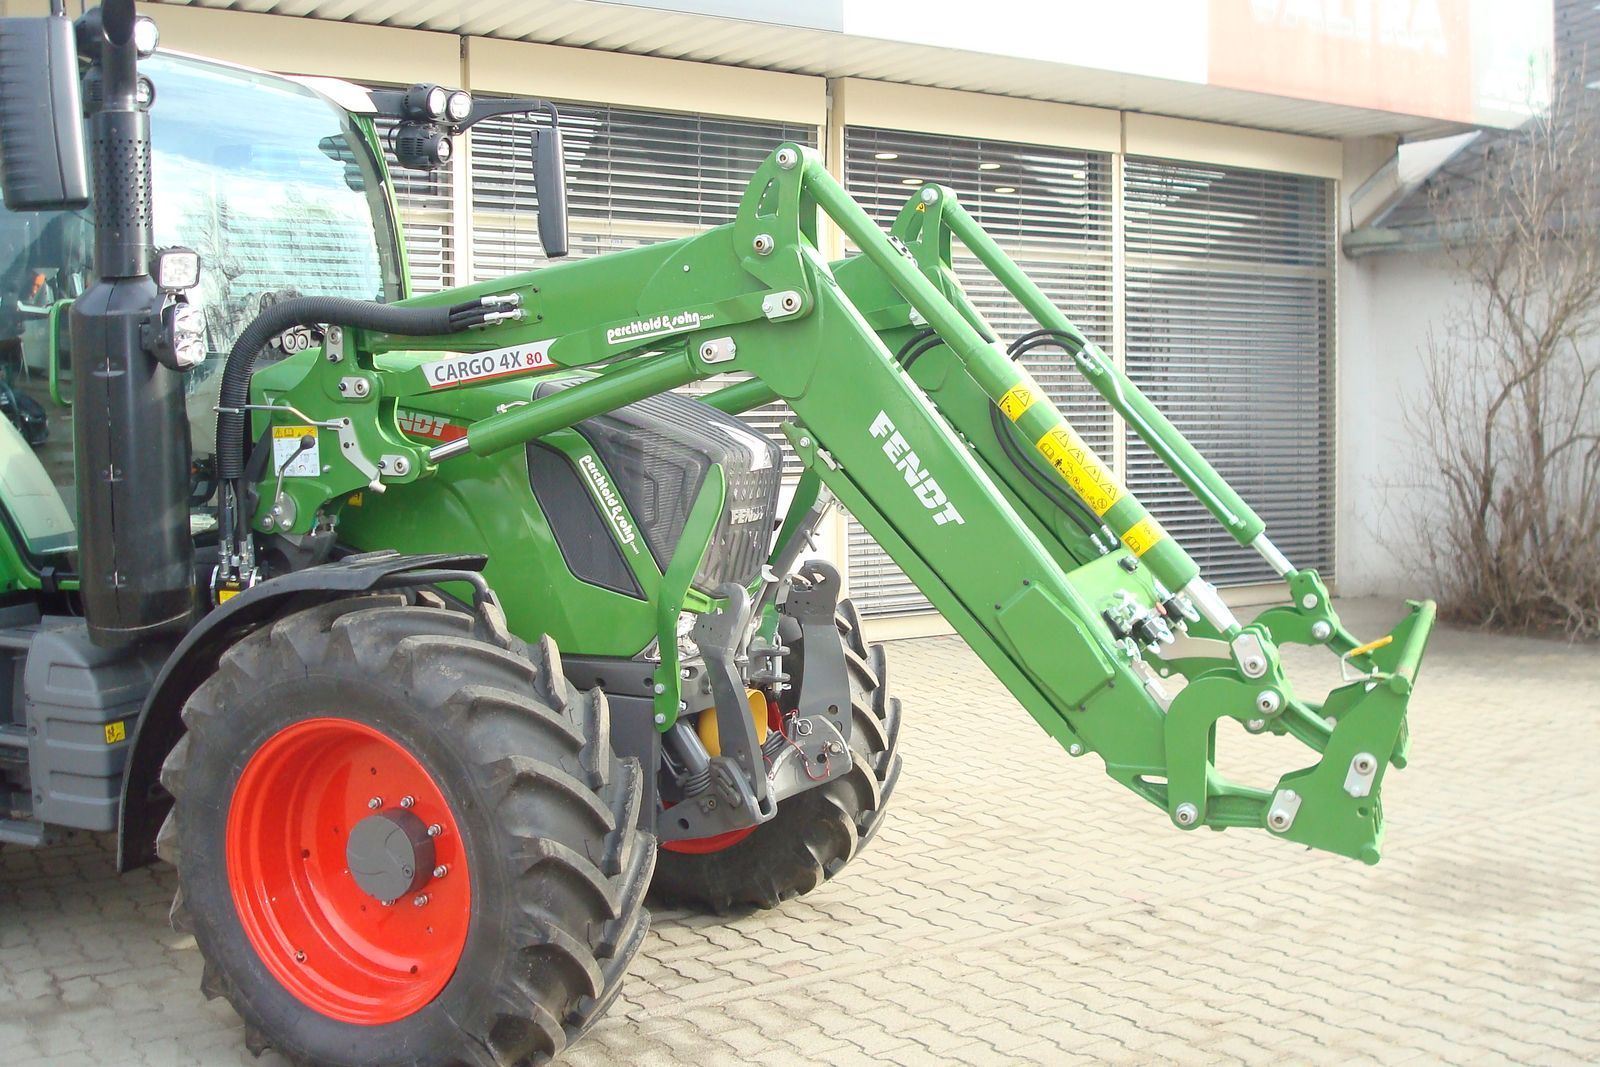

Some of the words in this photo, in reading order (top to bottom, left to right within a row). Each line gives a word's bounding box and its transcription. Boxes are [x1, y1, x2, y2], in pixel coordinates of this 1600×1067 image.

[434, 356, 495, 382] CARGO
[500, 350, 522, 370] 4X
[526, 351, 543, 366] 80
[868, 409, 966, 526] FENDT
